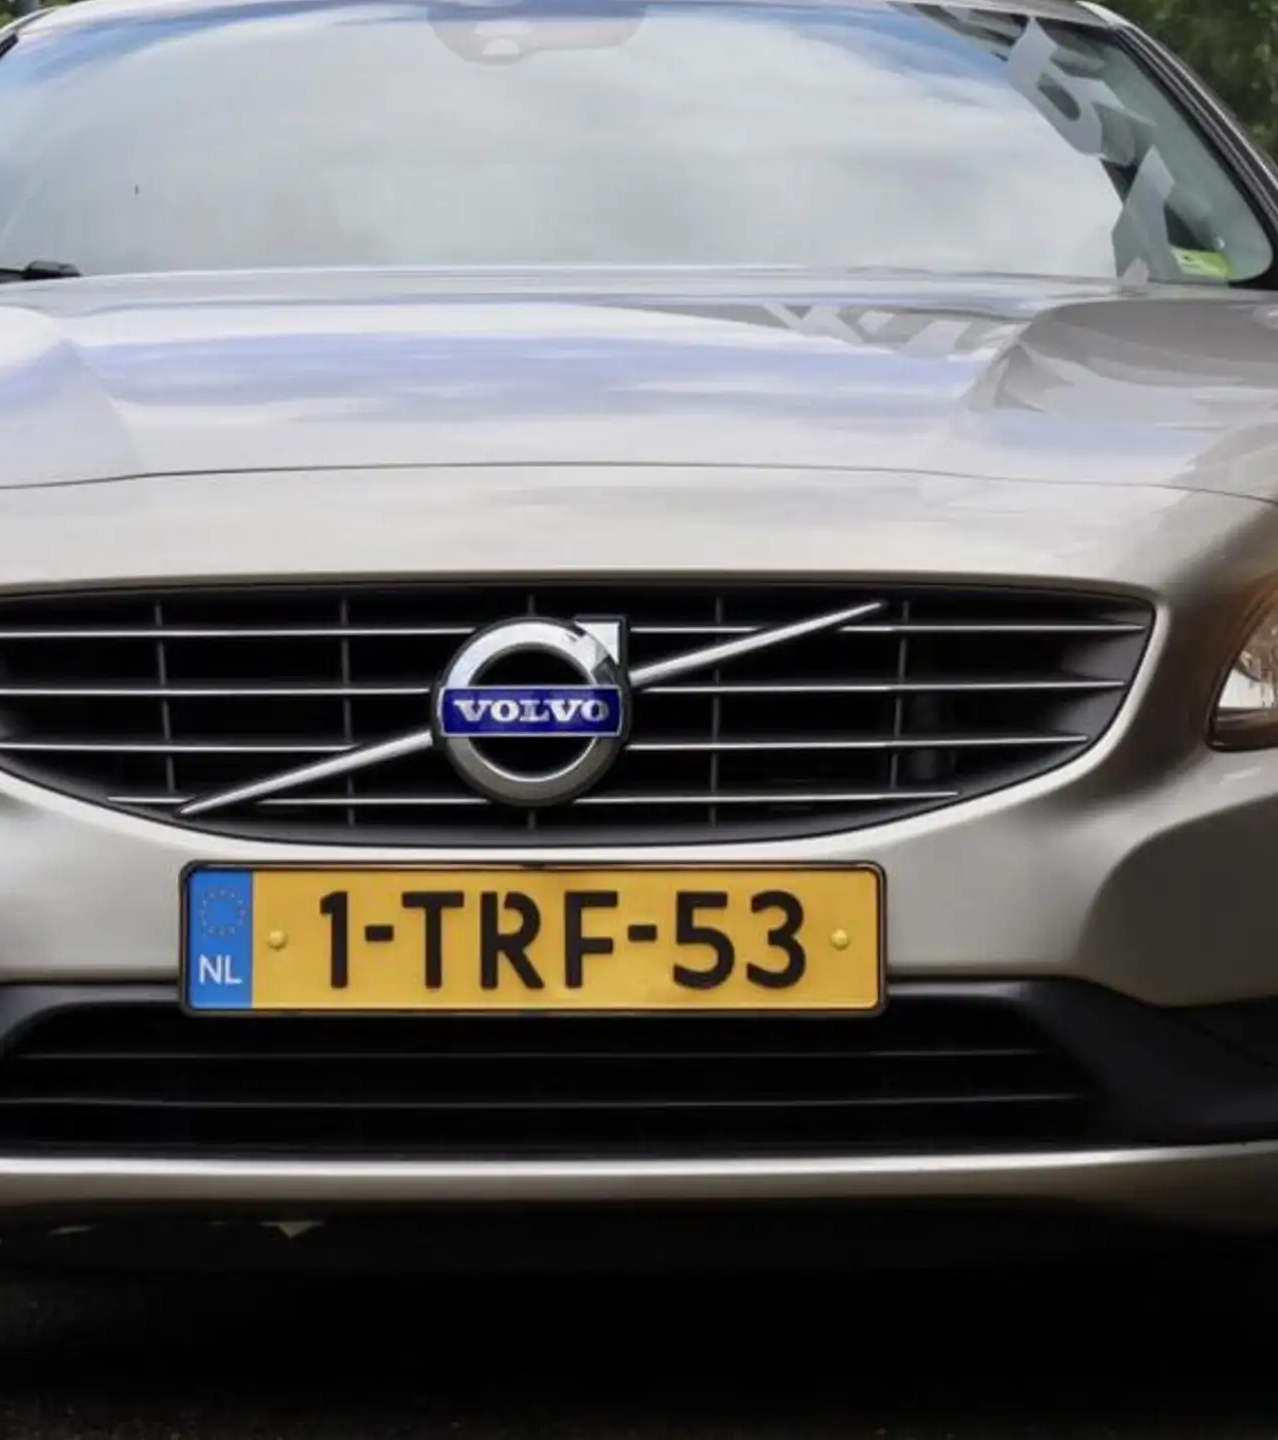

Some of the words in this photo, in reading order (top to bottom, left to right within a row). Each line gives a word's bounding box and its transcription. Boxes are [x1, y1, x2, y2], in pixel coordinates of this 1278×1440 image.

[452, 697, 611, 724] VOLVO
[319, 889, 807, 991] 1-TRF-53
[198, 954, 243, 986] NL
